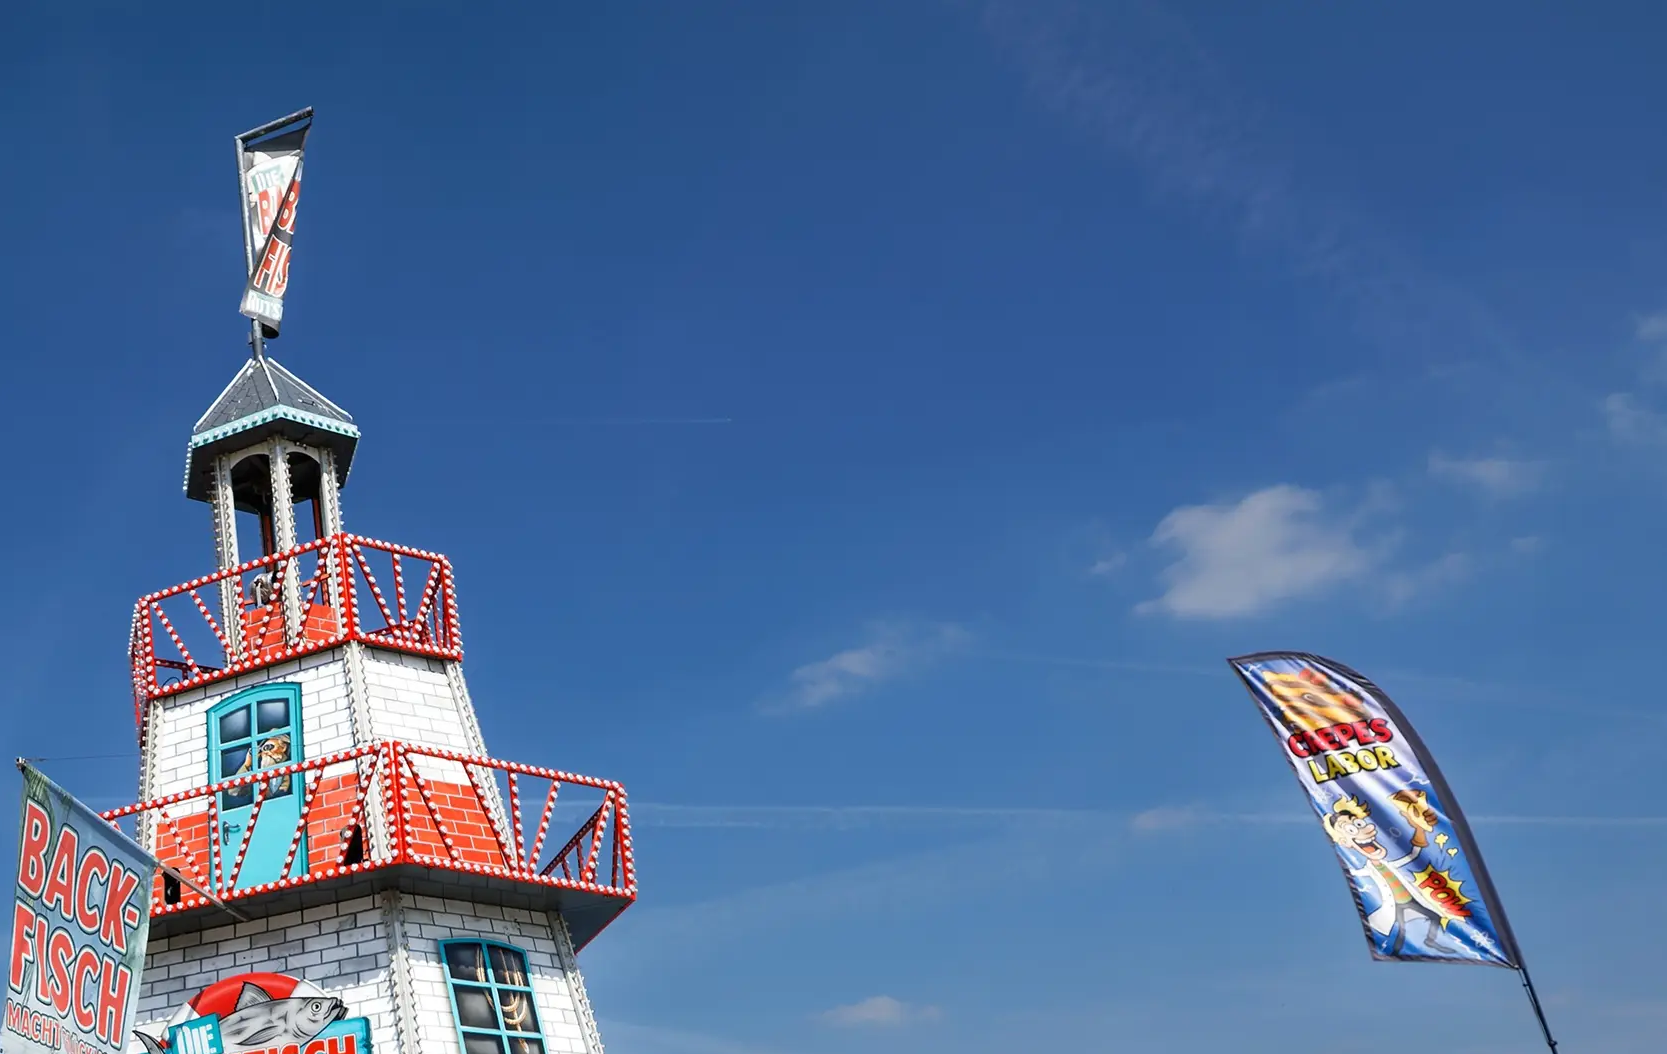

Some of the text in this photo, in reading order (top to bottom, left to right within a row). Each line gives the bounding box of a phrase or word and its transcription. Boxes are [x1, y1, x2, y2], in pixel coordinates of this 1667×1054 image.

[1286, 717, 1394, 759] CREPES
[1308, 746, 1400, 785] LABOR
[17, 797, 141, 956] BACK-
[1420, 870, 1472, 919] POW
[9, 899, 133, 1050] FISCH
[6, 998, 61, 1049] MACHT
